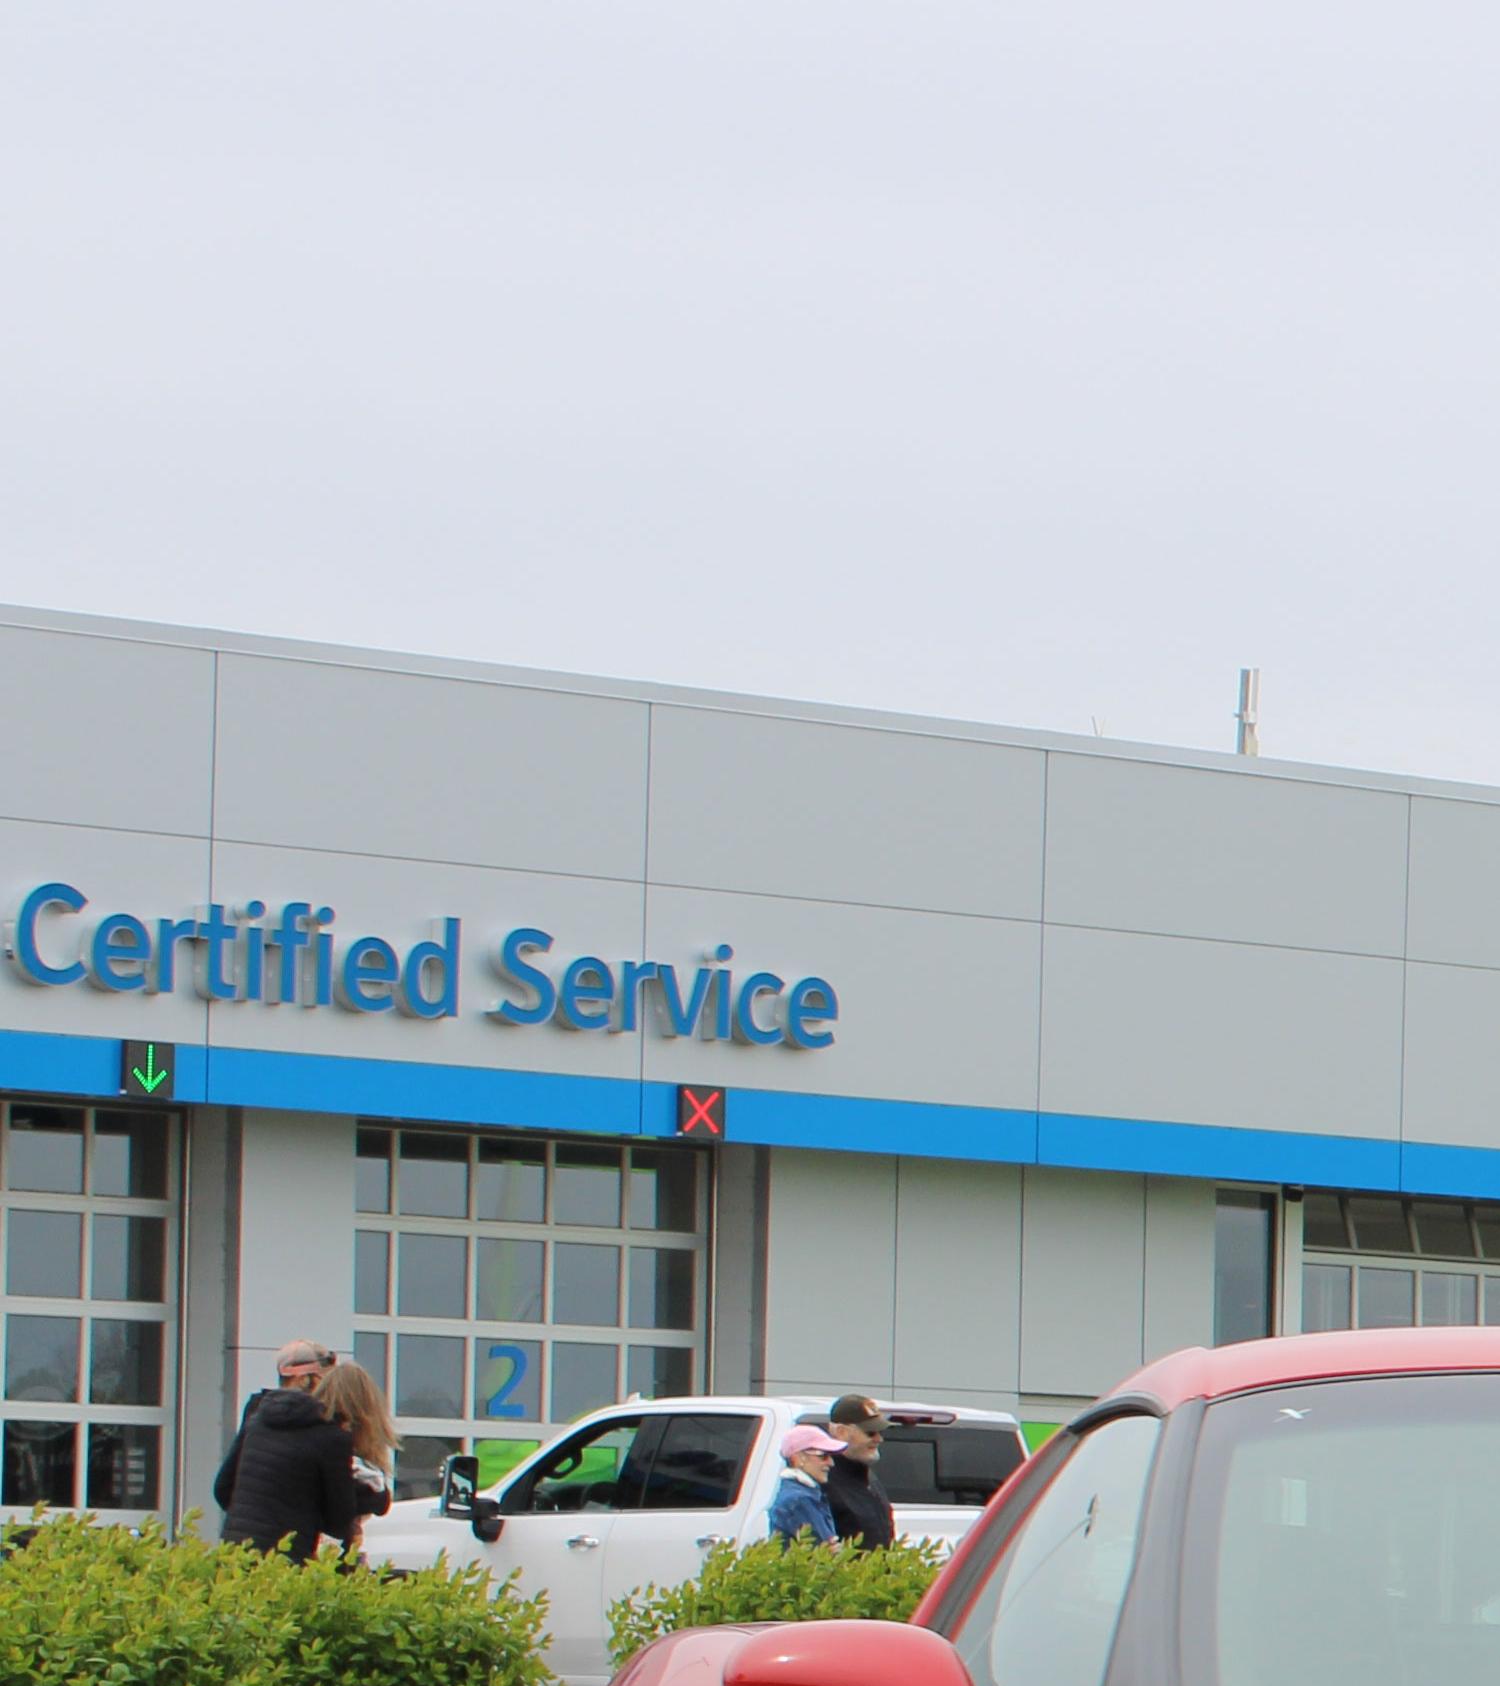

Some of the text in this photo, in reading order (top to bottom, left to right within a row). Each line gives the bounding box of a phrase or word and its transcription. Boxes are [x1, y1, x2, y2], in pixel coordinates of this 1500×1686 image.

[16, 882, 839, 1050] Certified Service
[487, 1344, 528, 1418] 2
